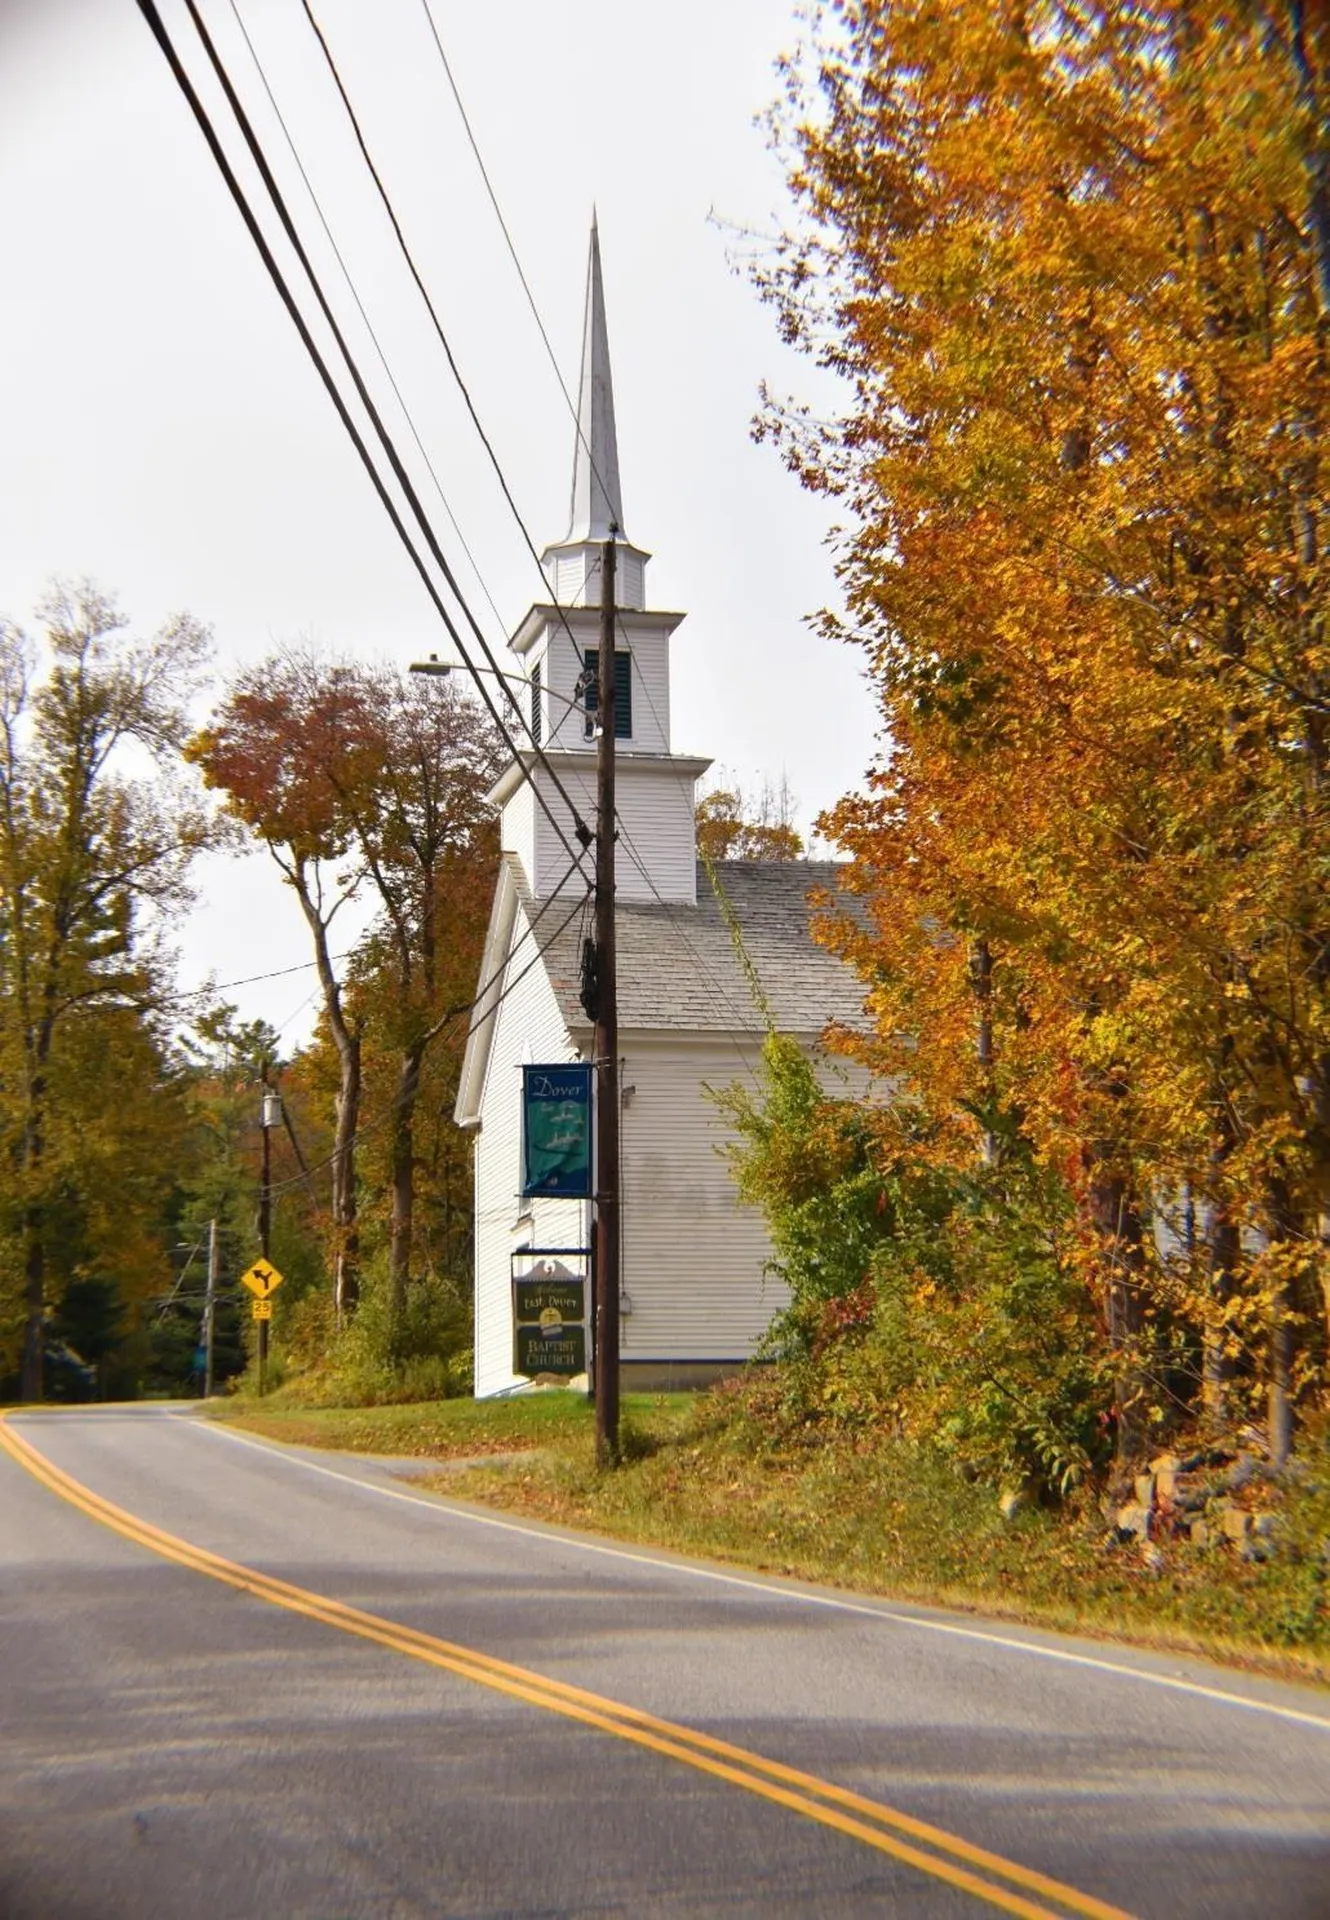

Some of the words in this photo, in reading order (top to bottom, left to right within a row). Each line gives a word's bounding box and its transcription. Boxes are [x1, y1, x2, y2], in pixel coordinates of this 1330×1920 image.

[529, 1075, 583, 1096] Dover
[255, 1302, 269, 1312] 25
[528, 1339, 576, 1353] BAPTIST
[526, 1354, 575, 1366] CHURCH
